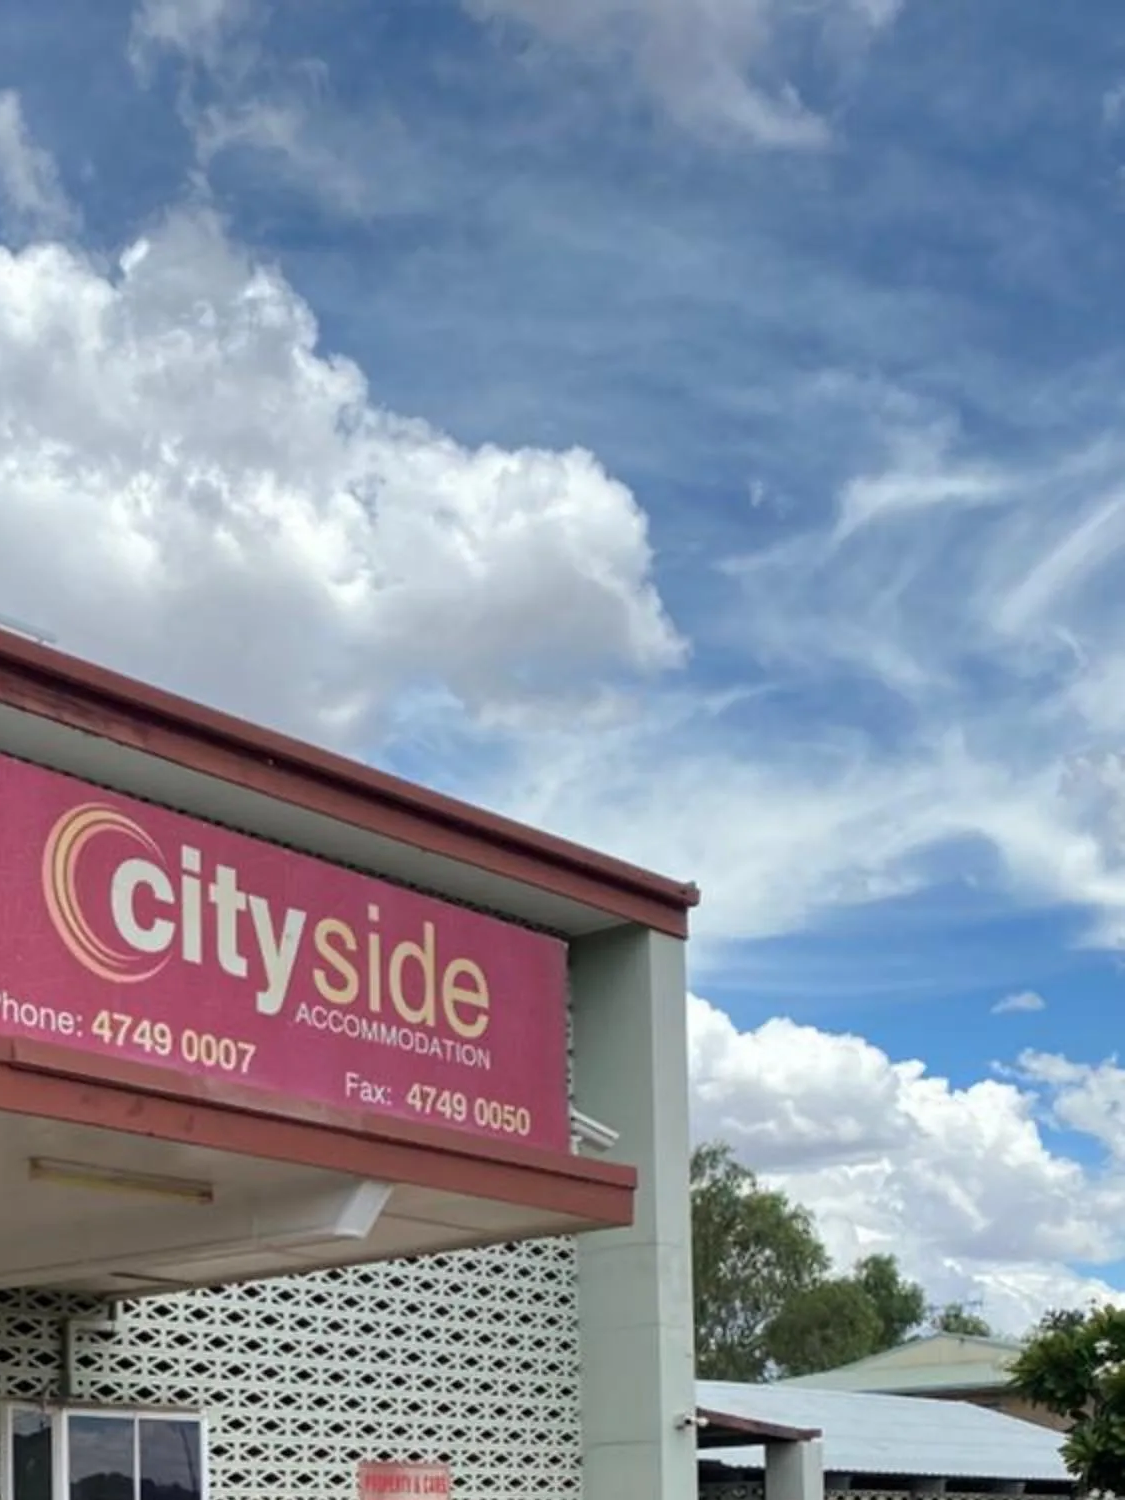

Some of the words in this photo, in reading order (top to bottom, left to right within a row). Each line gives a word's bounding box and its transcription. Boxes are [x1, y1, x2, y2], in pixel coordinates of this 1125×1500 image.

[91, 1010, 172, 1056] 4749
[181, 1029, 256, 1075] 0007
[295, 1001, 491, 1070] ACCOMMODATION
[344, 1071, 392, 1106] Fax:
[405, 1082, 467, 1123] 4749
[474, 1098, 531, 1137] 0050
